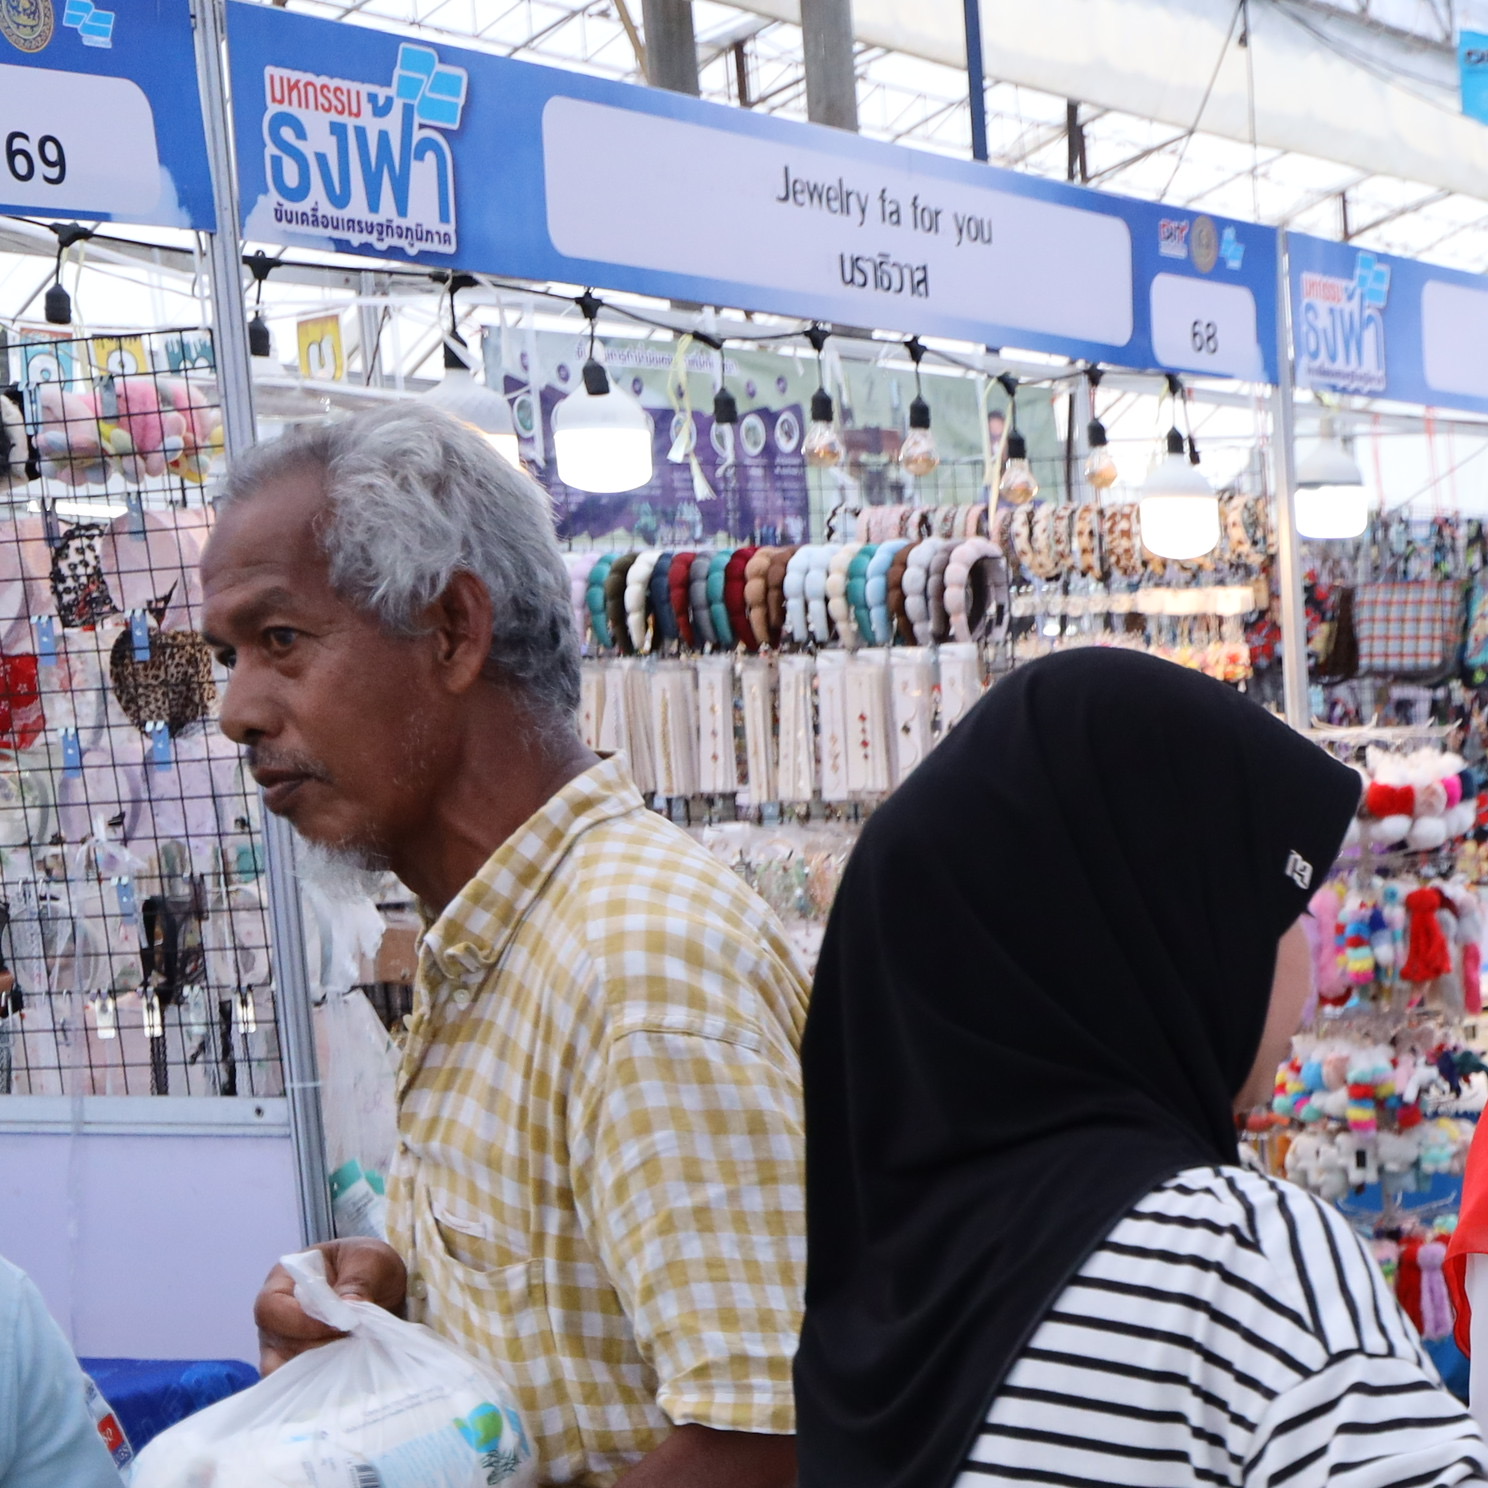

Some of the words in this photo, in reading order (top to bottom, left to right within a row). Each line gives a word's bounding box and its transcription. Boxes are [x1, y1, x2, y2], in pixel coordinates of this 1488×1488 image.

[269, 73, 362, 118] มหกรรม
[5, 131, 67, 185] 69
[267, 92, 452, 225] ธงฟ้า
[776, 166, 870, 227] Jewelry
[880, 186, 902, 226] fa
[911, 193, 943, 235] for
[953, 209, 994, 246] you
[838, 249, 931, 298] นราธิวาส
[1190, 319, 1219, 354] 68
